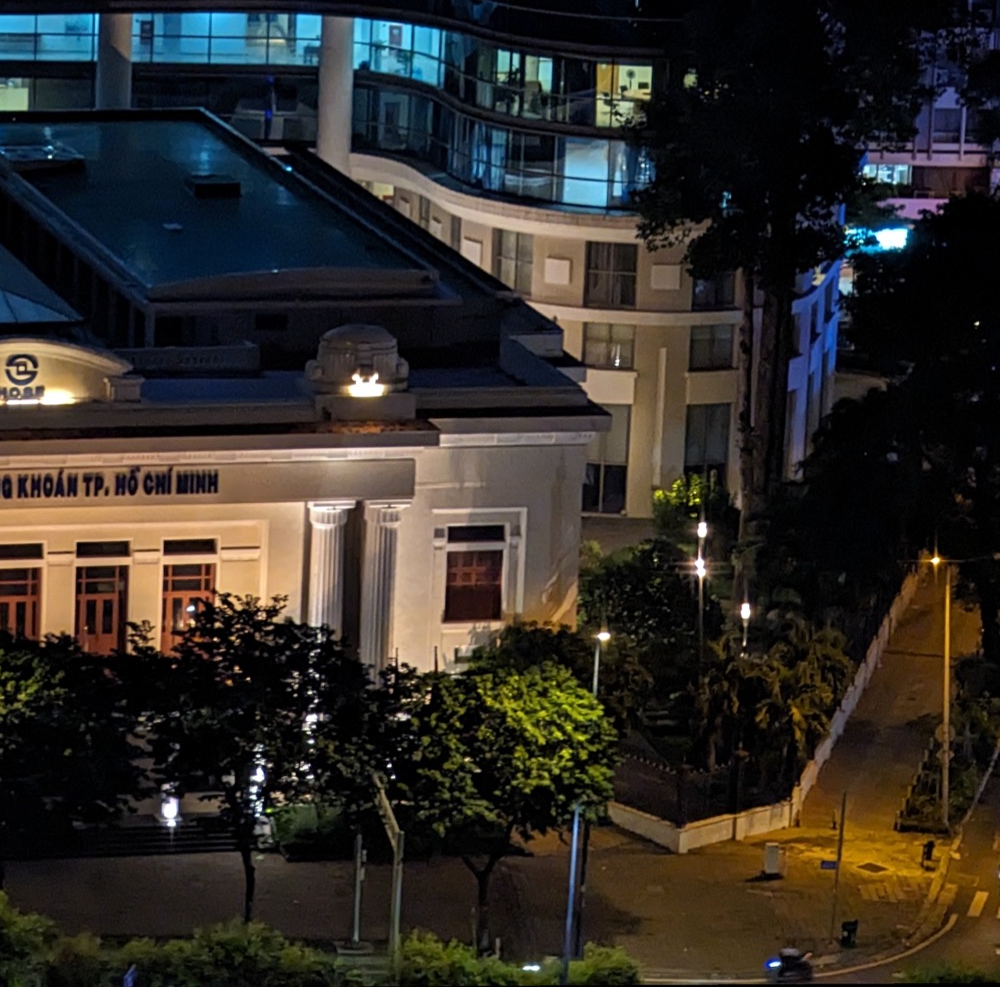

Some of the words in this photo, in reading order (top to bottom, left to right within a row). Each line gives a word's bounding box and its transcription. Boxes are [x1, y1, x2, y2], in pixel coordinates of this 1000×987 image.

[17, 469, 79, 499] KHOÁN
[83, 475, 110, 497] TP.
[143, 467, 173, 495] CHÍ
[176, 470, 219, 494] MINH
